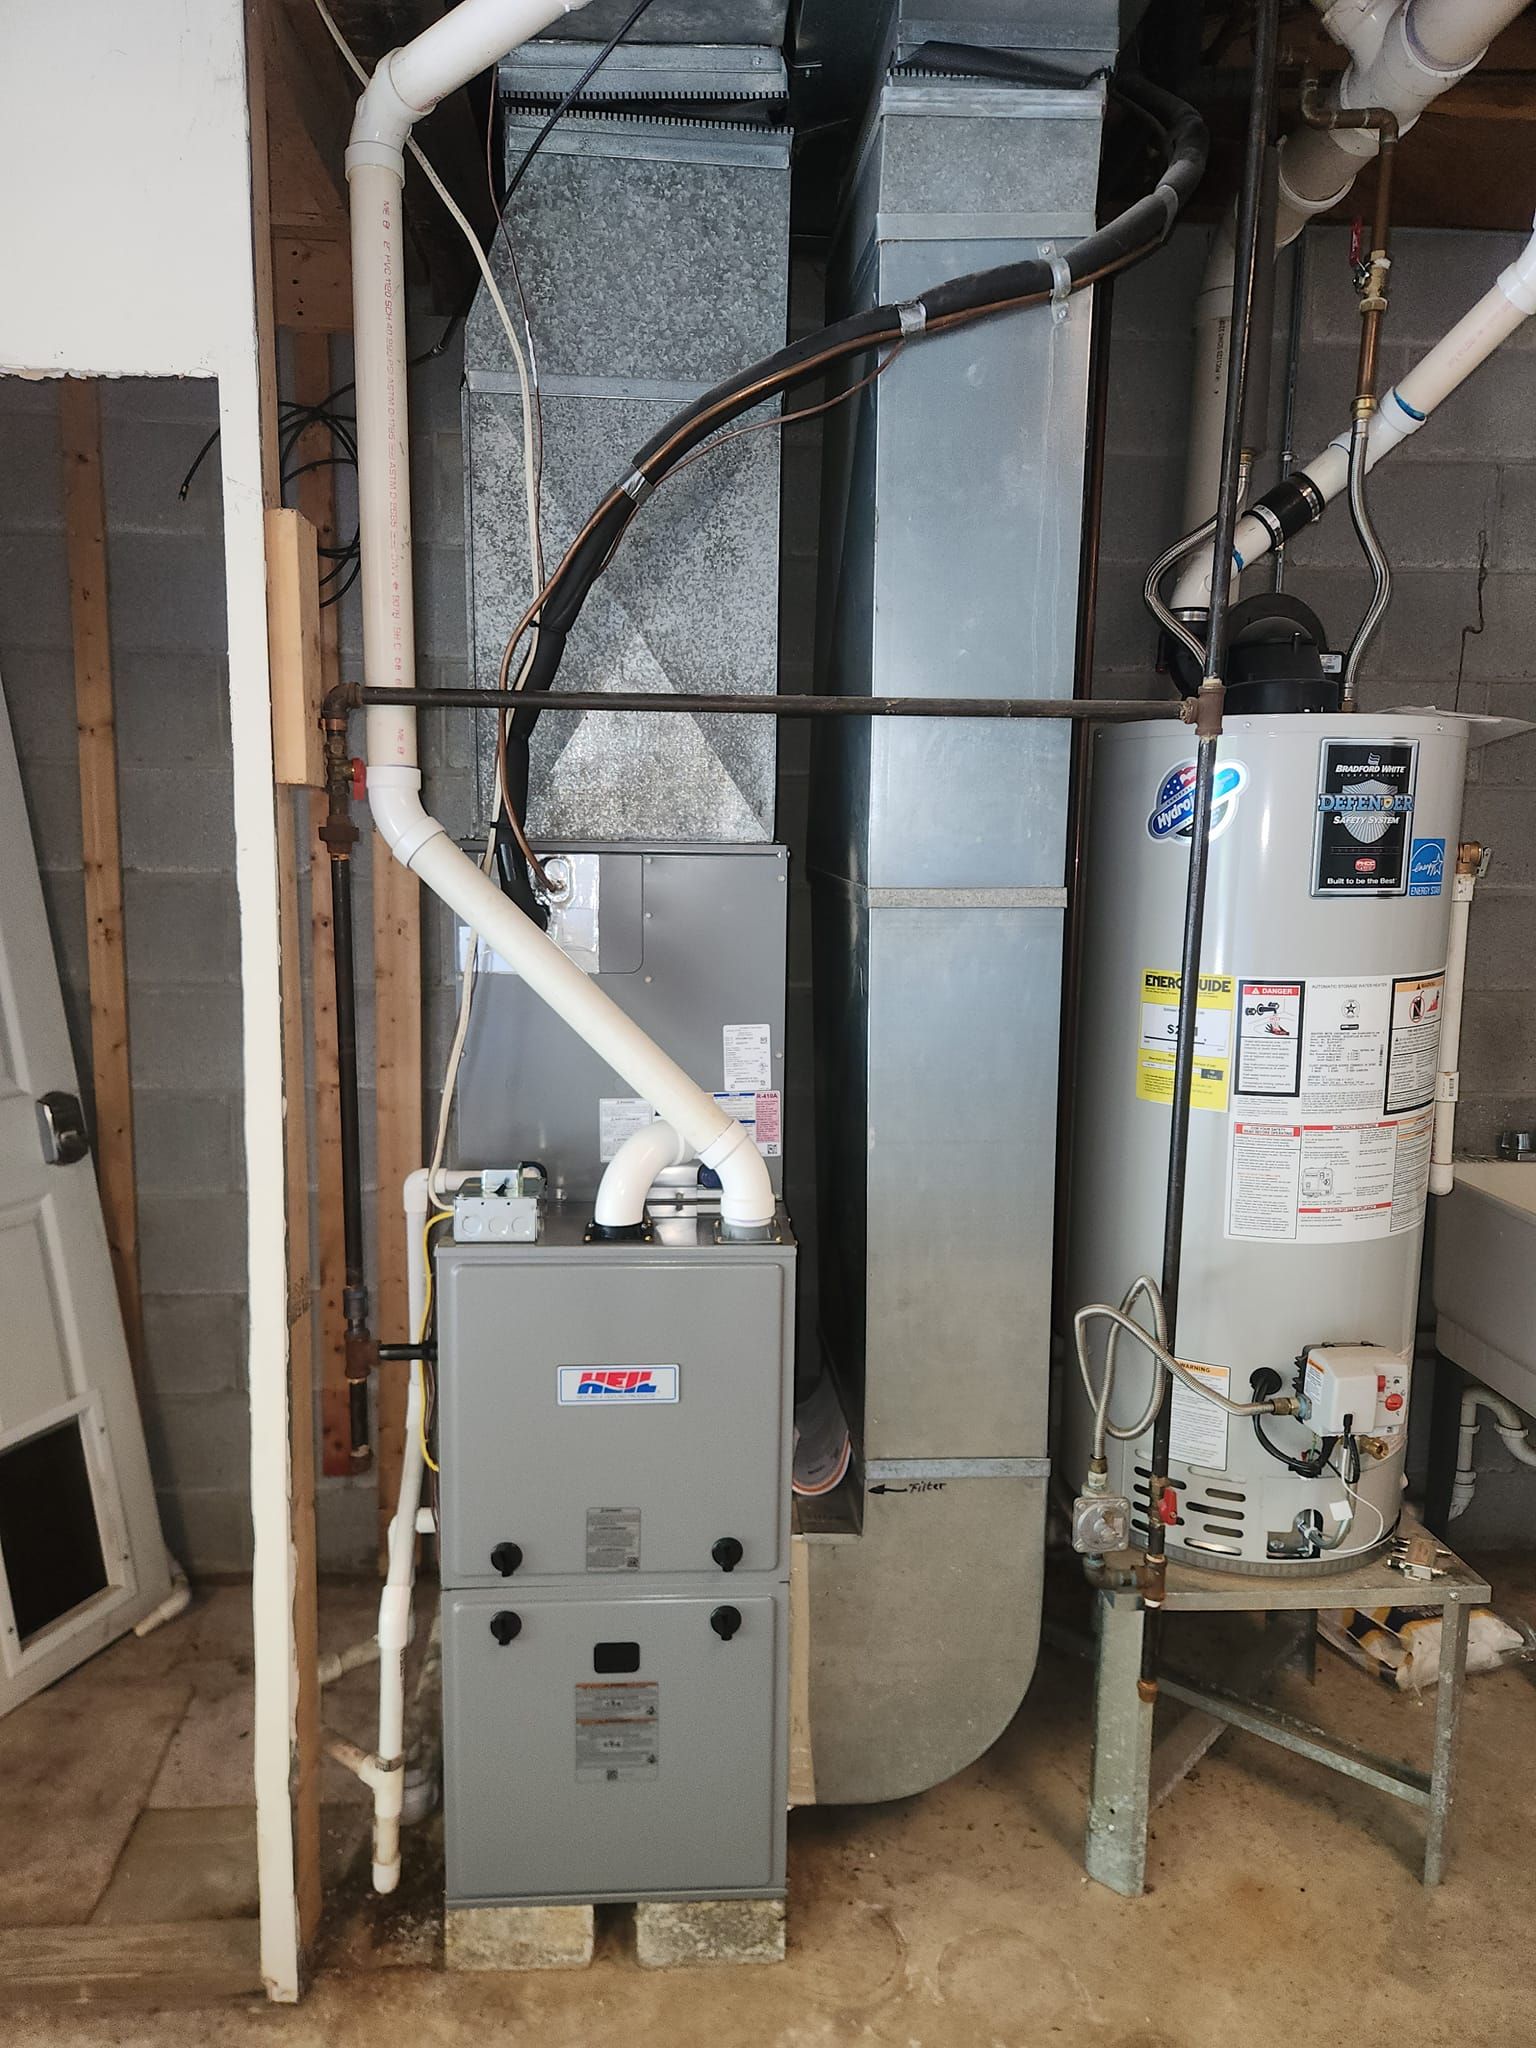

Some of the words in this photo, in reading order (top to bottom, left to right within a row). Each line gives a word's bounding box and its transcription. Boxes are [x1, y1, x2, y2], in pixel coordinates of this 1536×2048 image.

[383, 254, 391, 276] PVC
[384, 299, 392, 321] SCH
[388, 462, 396, 490] ASTM
[1335, 764, 1380, 773] BRADFORD
[1381, 764, 1406, 774] WHITE
[1318, 793, 1414, 812] DEFENDER
[1333, 816, 1367, 825] SAFETY
[1367, 816, 1400, 825] SYSTEM
[1327, 877, 1345, 885] Built
[1355, 877, 1366, 885] be
[1367, 877, 1379, 885] the
[1380, 877, 1396, 885] Best
[1410, 886, 1430, 896] ENERGY
[577, 1372, 657, 1394] HEIL
[909, 1480, 947, 1494] Filter
